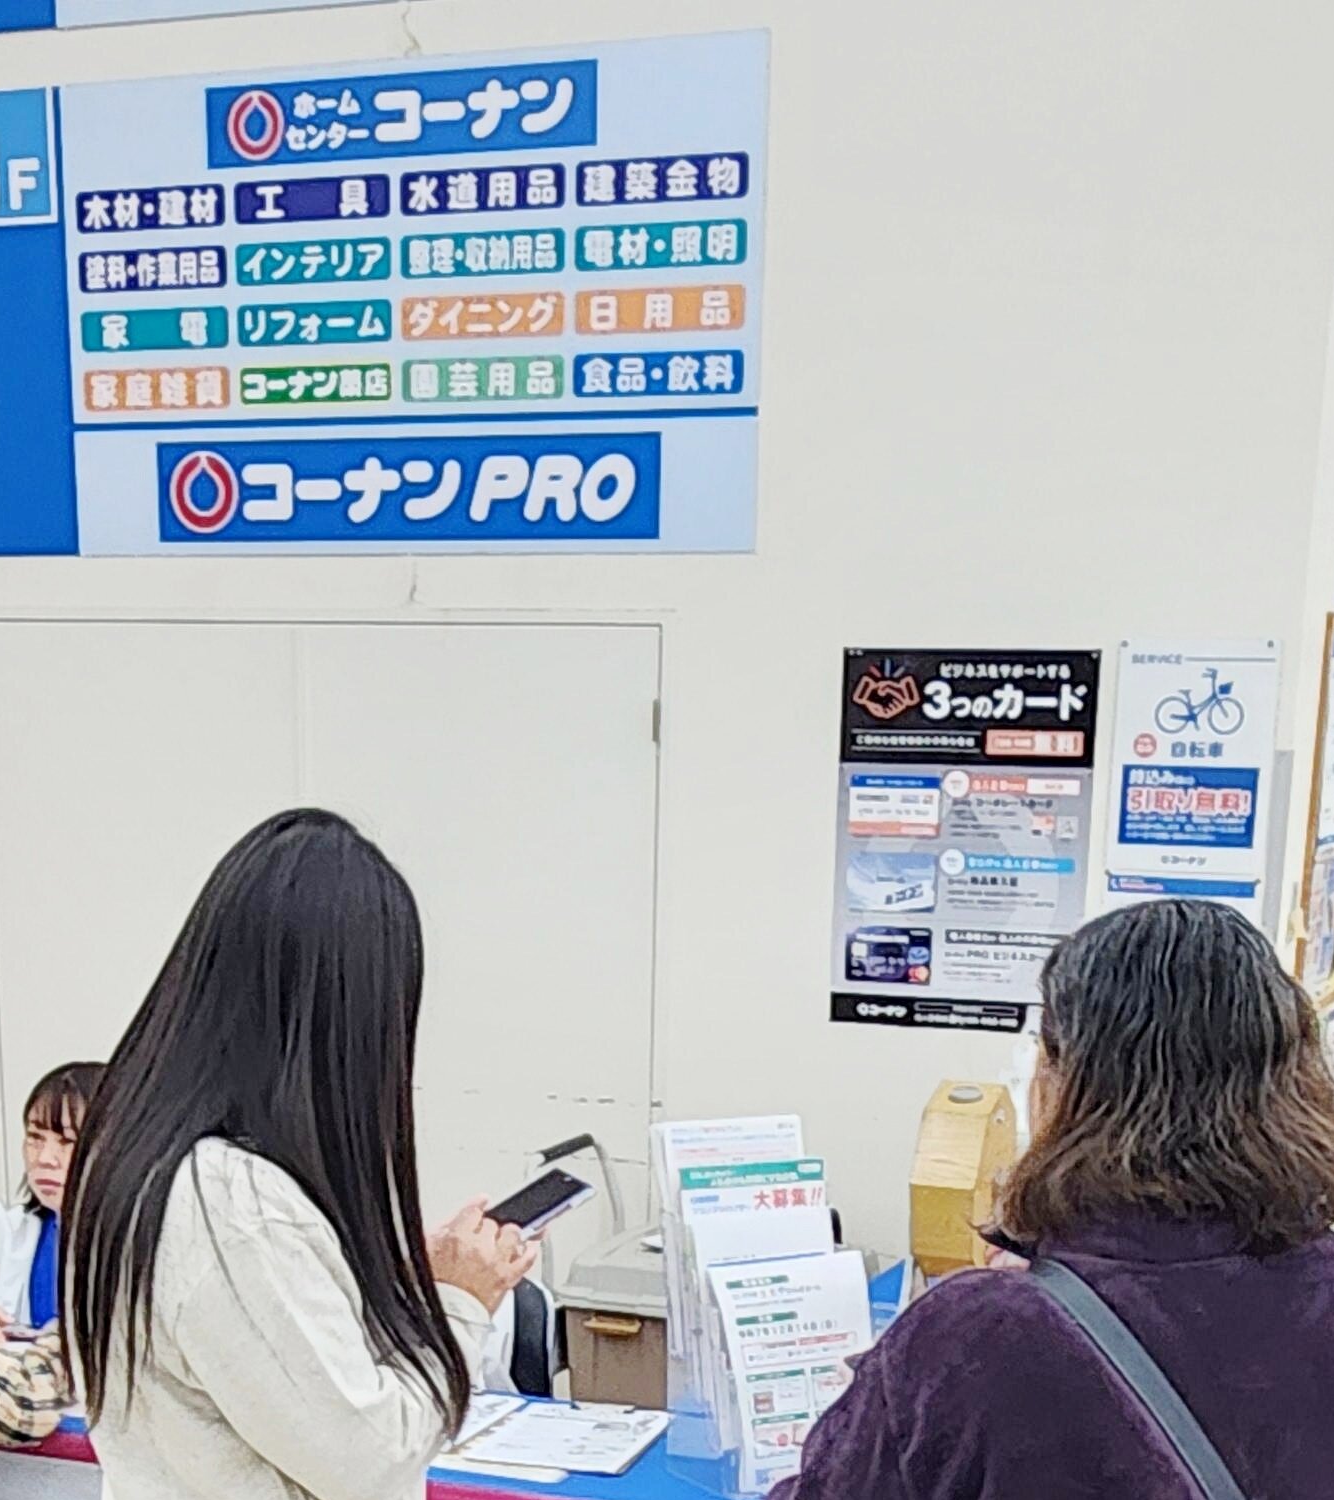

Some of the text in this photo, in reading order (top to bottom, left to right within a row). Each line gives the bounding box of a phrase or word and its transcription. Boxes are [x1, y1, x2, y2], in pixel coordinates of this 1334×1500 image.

[293, 90, 362, 115] ホーム
[373, 77, 574, 141] コーナン
[285, 121, 370, 151] センター
[408, 169, 557, 211] 水道用品
[583, 157, 740, 202] 建築金物
[82, 188, 218, 229] 木材・建材
[243, 243, 384, 280] インテリア
[244, 305, 385, 342] リフォーム
[409, 295, 557, 335] ダイニング
[241, 453, 636, 523] コーナン PRO
[922, 680, 1088, 721] 3つのカード
[1170, 741, 1224, 758] 自転車
